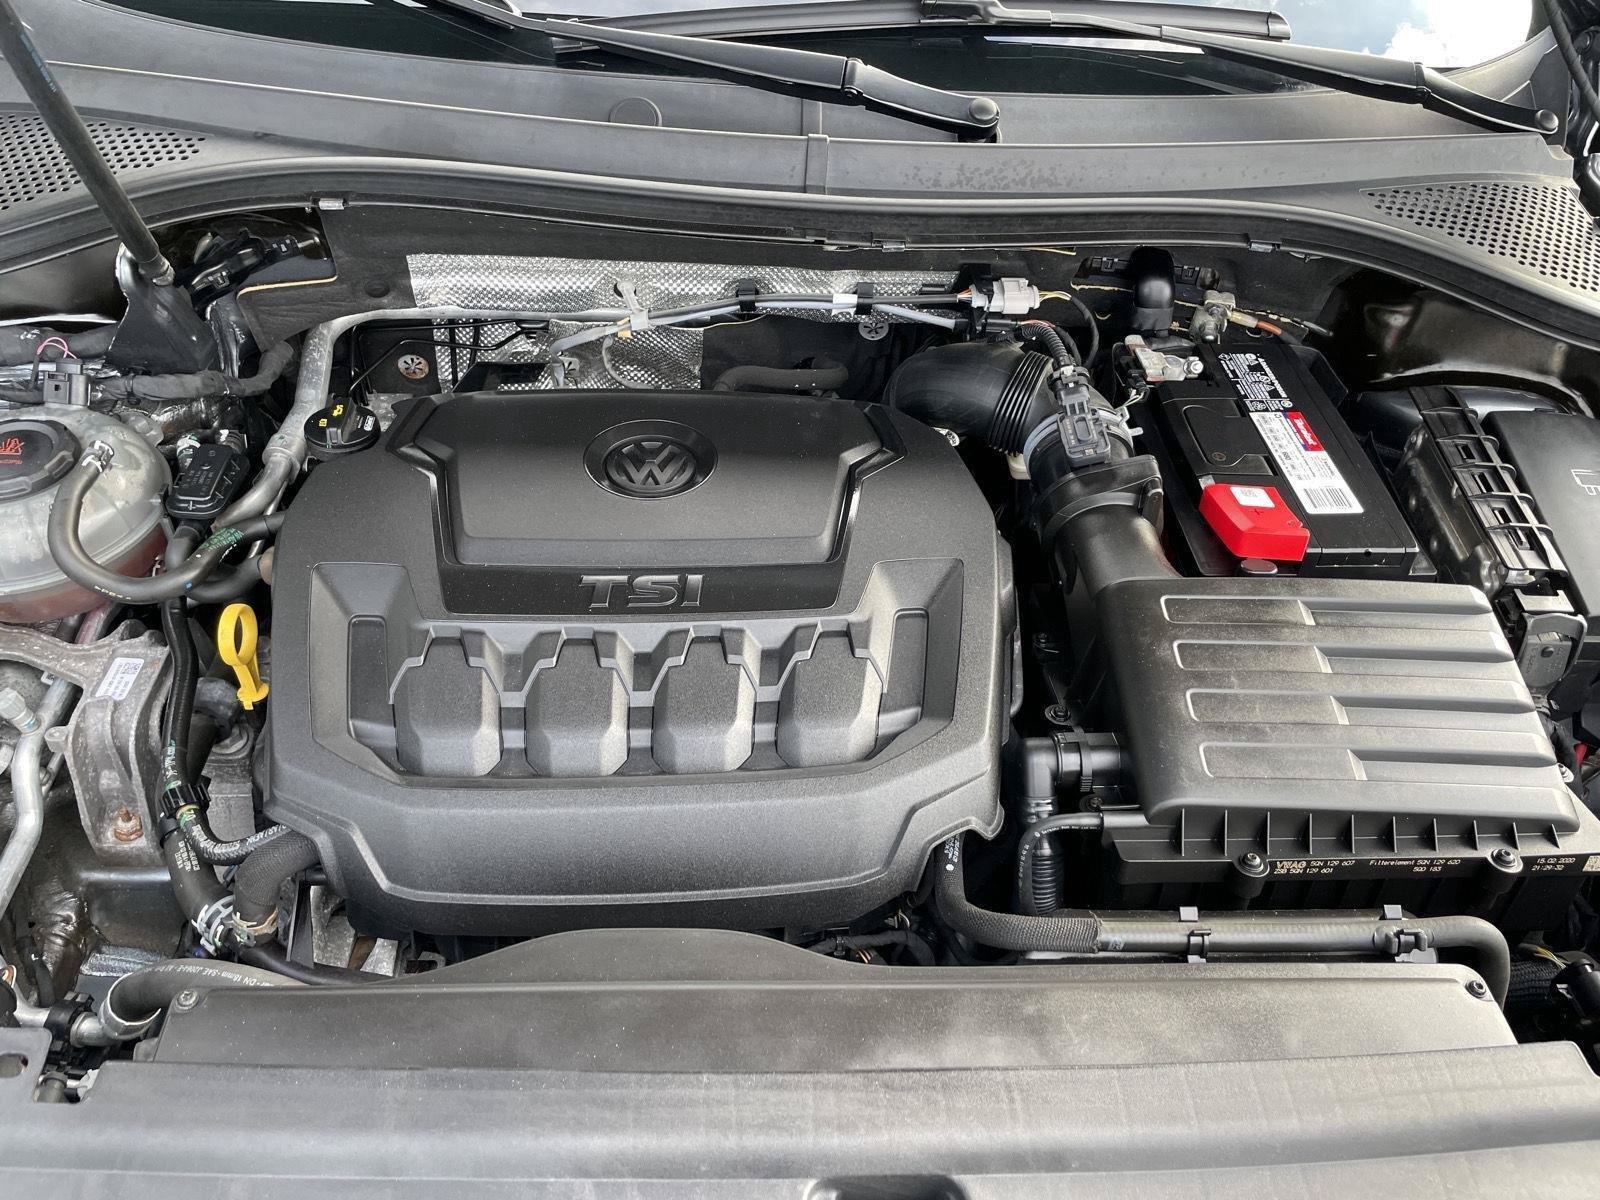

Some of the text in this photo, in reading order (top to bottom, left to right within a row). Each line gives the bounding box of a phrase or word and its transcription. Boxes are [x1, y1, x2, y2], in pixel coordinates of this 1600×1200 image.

[604, 435, 697, 493] VW
[579, 574, 705, 607] TSI
[1276, 860, 1307, 869] VWAG
